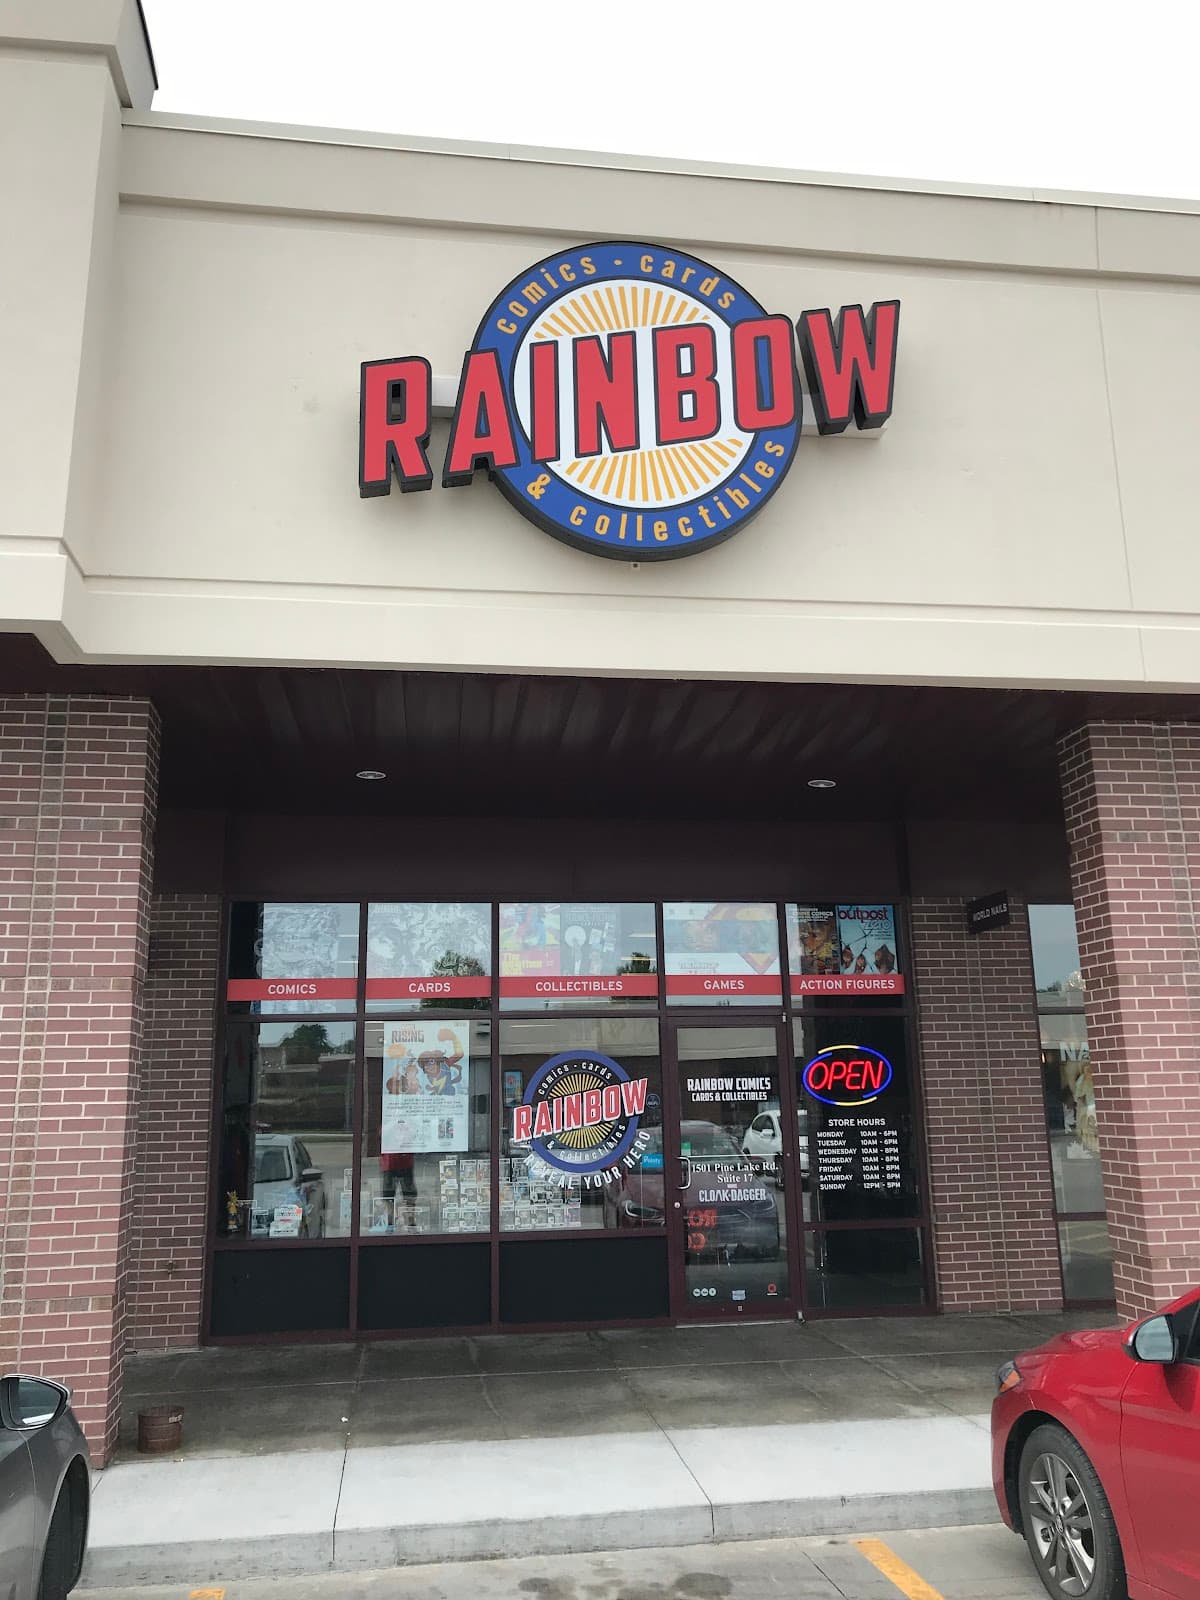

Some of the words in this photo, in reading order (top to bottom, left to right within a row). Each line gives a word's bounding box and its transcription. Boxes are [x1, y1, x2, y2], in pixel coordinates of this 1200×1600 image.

[359, 299, 900, 494] RAINBOW
[526, 473, 551, 500] &
[569, 441, 785, 541] collectibles
[838, 907, 889, 924] outpost
[267, 983, 317, 995] COMICS
[408, 982, 451, 993] CARDS
[535, 980, 623, 992] COLLECTIBLES
[703, 980, 745, 990] GAMES
[799, 979, 843, 990] ACTION
[846, 979, 896, 990] FIGURES
[391, 1030, 425, 1044] RISING
[538, 1064, 570, 1095] comics
[581, 1061, 613, 1080] cards
[808, 1060, 884, 1091] OPEN
[687, 1078, 734, 1092] RAINBOW
[735, 1077, 771, 1091] COMICS
[691, 1092, 713, 1102] CARDS
[715, 1092, 720, 1101] &
[722, 1091, 768, 1101] COLLECTIBLES
[512, 1077, 649, 1143] RAINBOW
[828, 1119, 856, 1127] STORE
[857, 1118, 886, 1127] HOURS
[546, 1140, 555, 1150] &
[523, 1153, 575, 1190] REVEAL
[583, 1165, 622, 1190] YOUR
[622, 1130, 651, 1169] HERO
[692, 1164, 712, 1173] 1501
[714, 1163, 735, 1173] Pine
[737, 1161, 760, 1172] Lake
[762, 1161, 779, 1172] Rd.
[717, 1174, 741, 1184] Suite
[743, 1173, 754, 1183] 17
